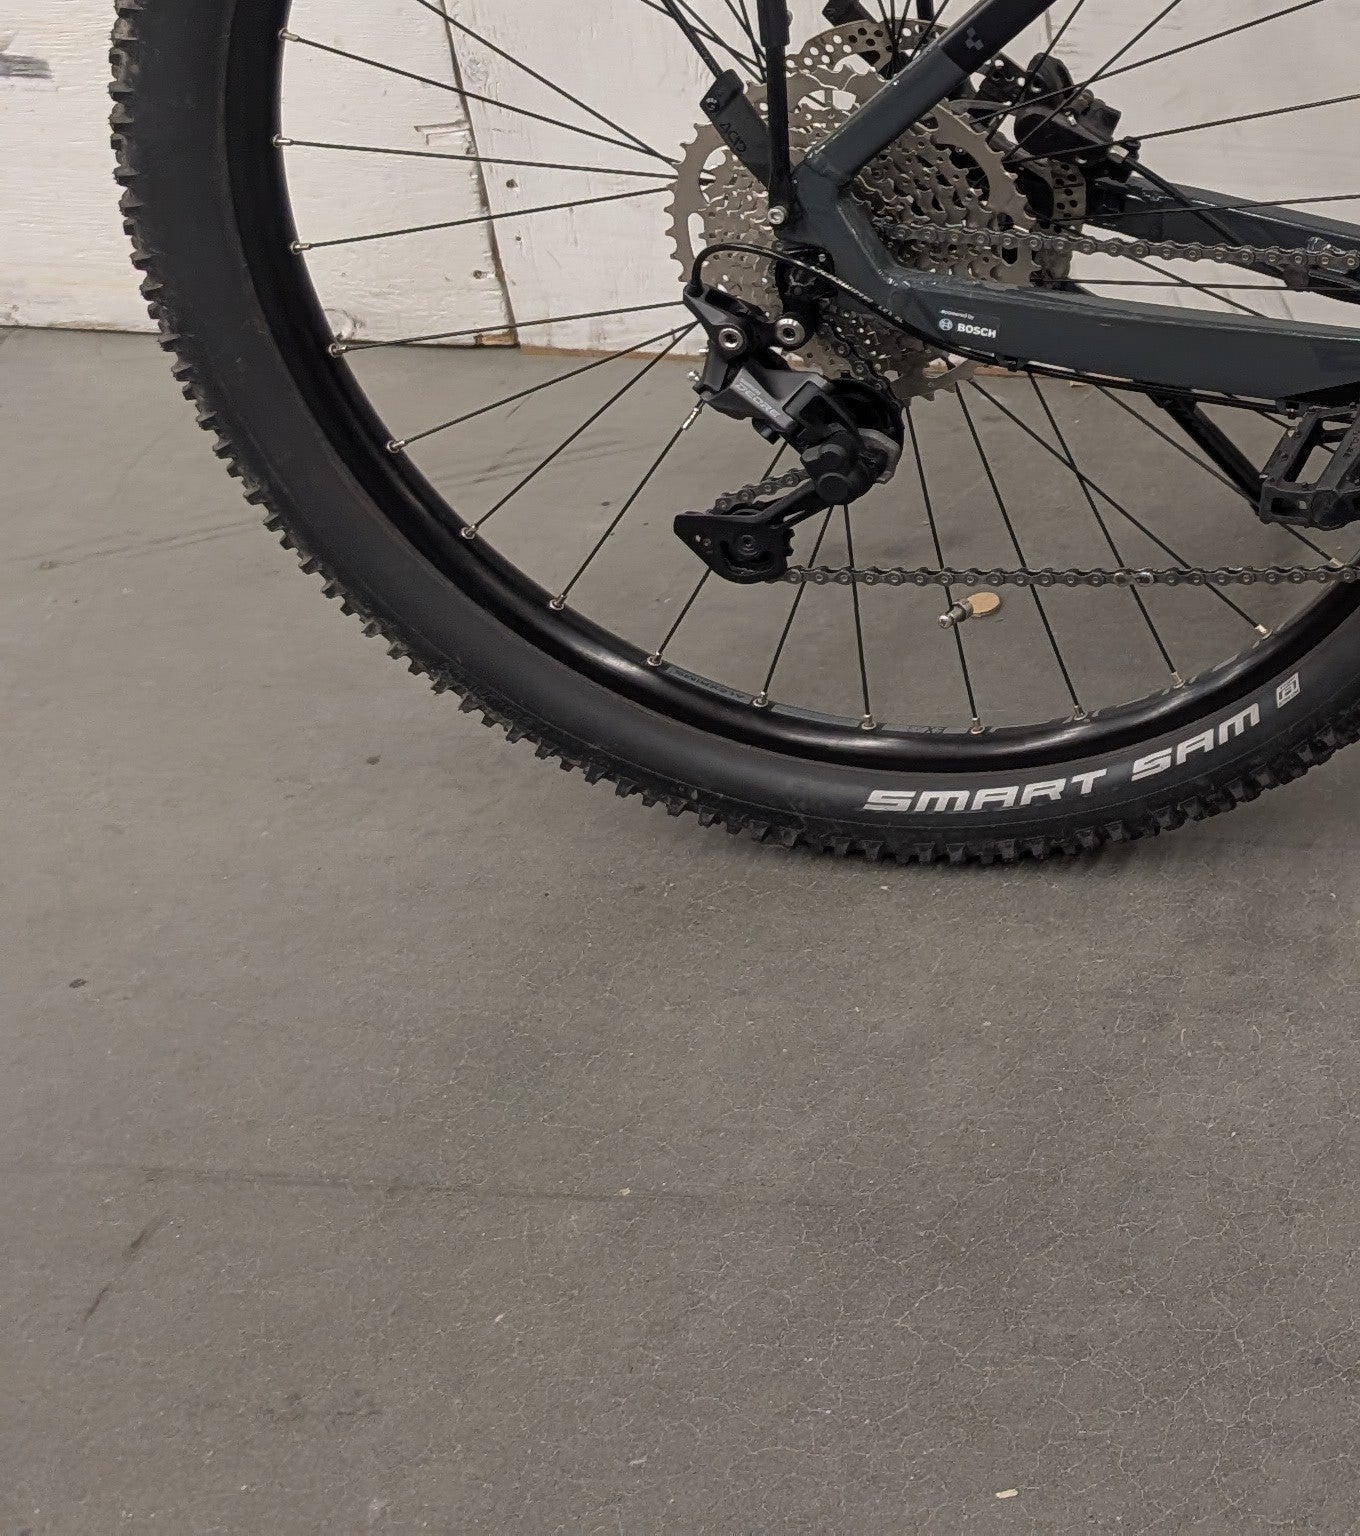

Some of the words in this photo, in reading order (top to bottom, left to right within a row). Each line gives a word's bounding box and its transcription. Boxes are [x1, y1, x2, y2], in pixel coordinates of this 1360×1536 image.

[957, 322, 997, 339] BOSCH
[735, 382, 781, 418] DEORE
[862, 768, 1107, 813] SMART
[1130, 702, 1261, 782] SAM
